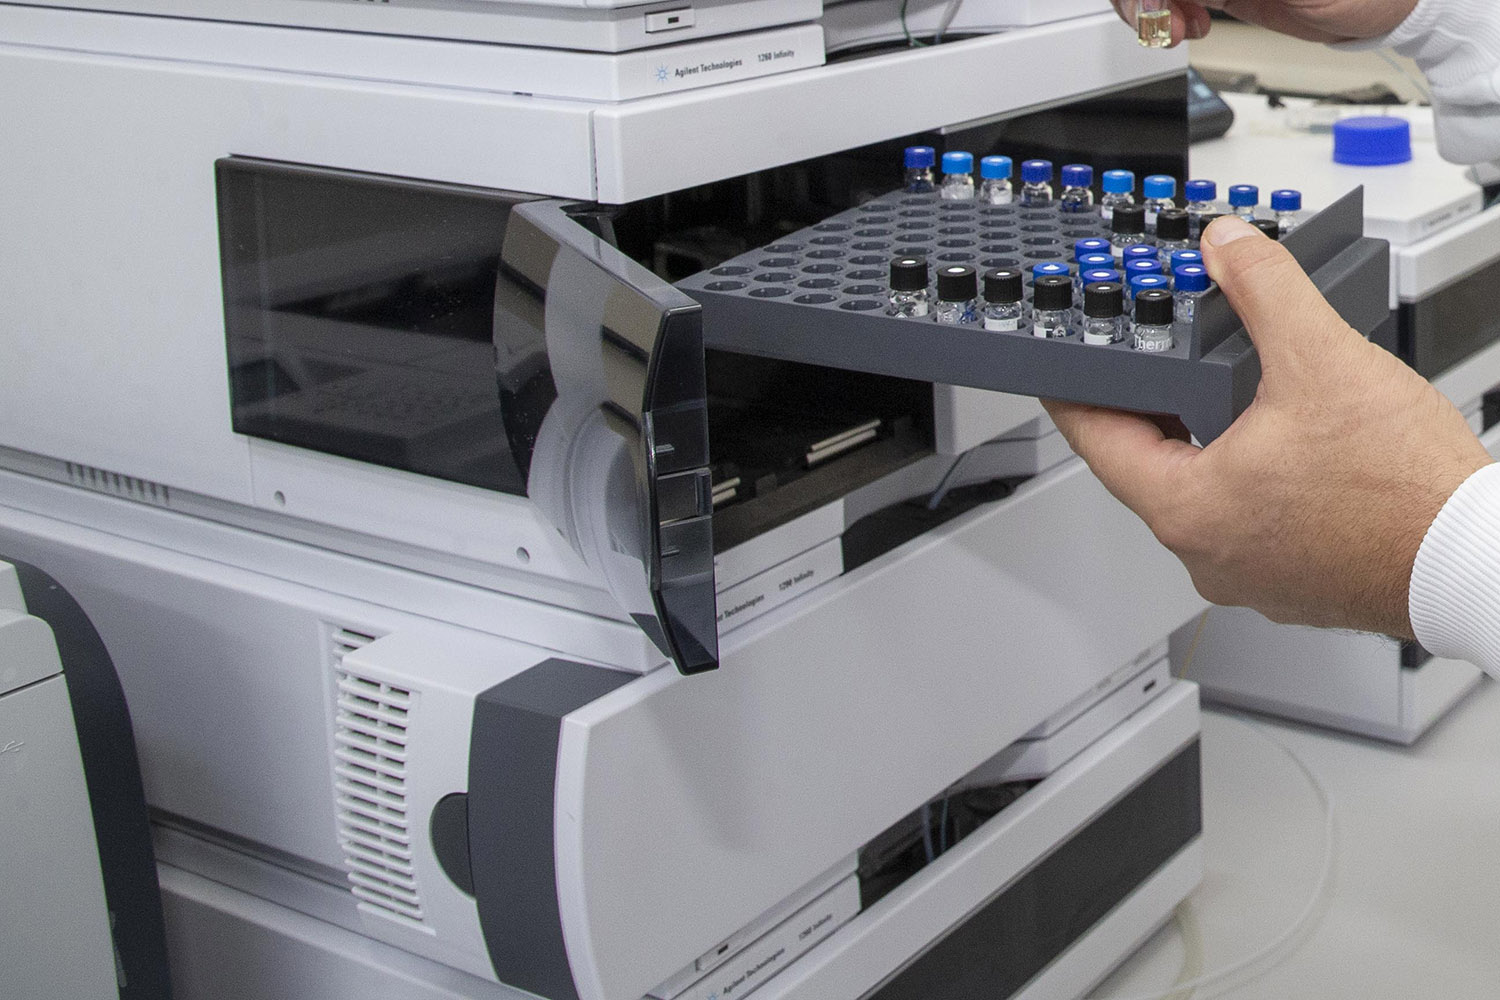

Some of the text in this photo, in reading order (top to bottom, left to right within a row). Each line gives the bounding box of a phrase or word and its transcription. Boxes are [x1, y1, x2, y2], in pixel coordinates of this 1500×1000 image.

[675, 66, 699, 79] Agilent
[700, 59, 742, 73] Technologies
[773, 50, 795, 60] Infinity
[725, 594, 765, 617] Technologies
